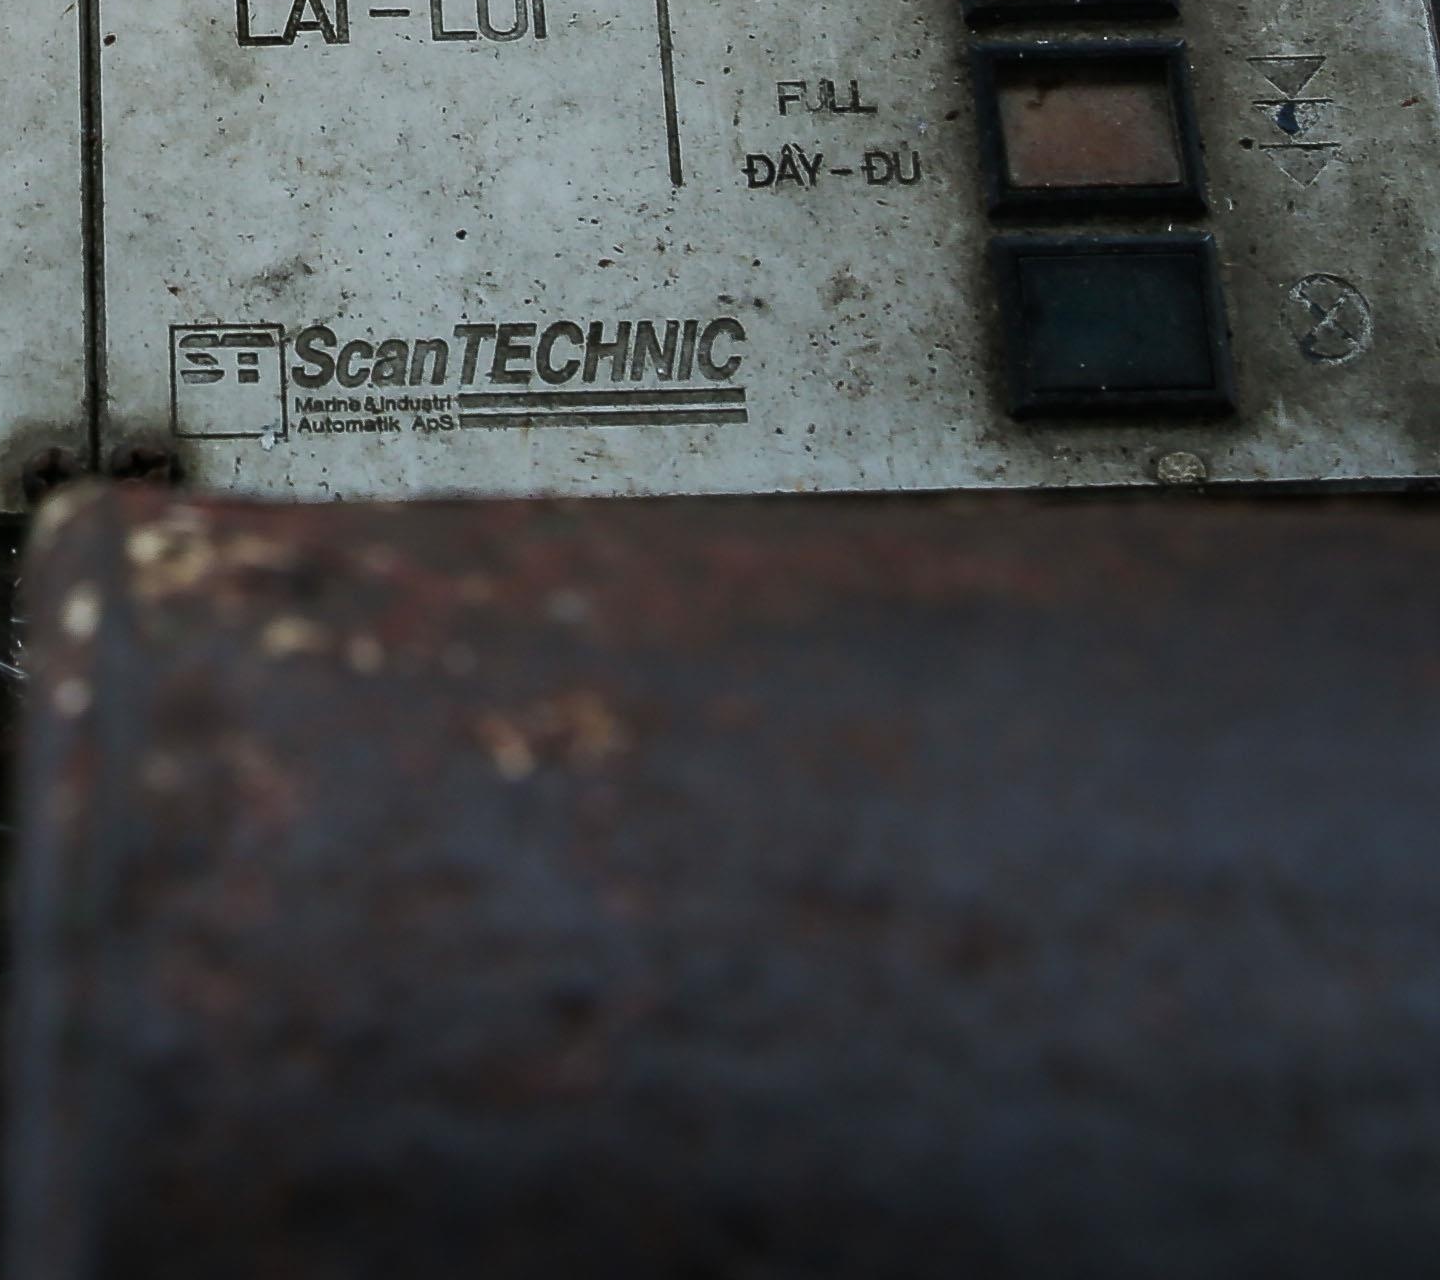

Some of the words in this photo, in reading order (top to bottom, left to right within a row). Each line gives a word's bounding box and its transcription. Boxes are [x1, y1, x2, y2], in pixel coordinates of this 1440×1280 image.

[776, 79, 879, 116] FULL
[291, 317, 746, 388] ScanTECHNIC
[295, 396, 361, 413] Marine
[297, 415, 401, 433] Automatik
[412, 414, 454, 432] ApS
